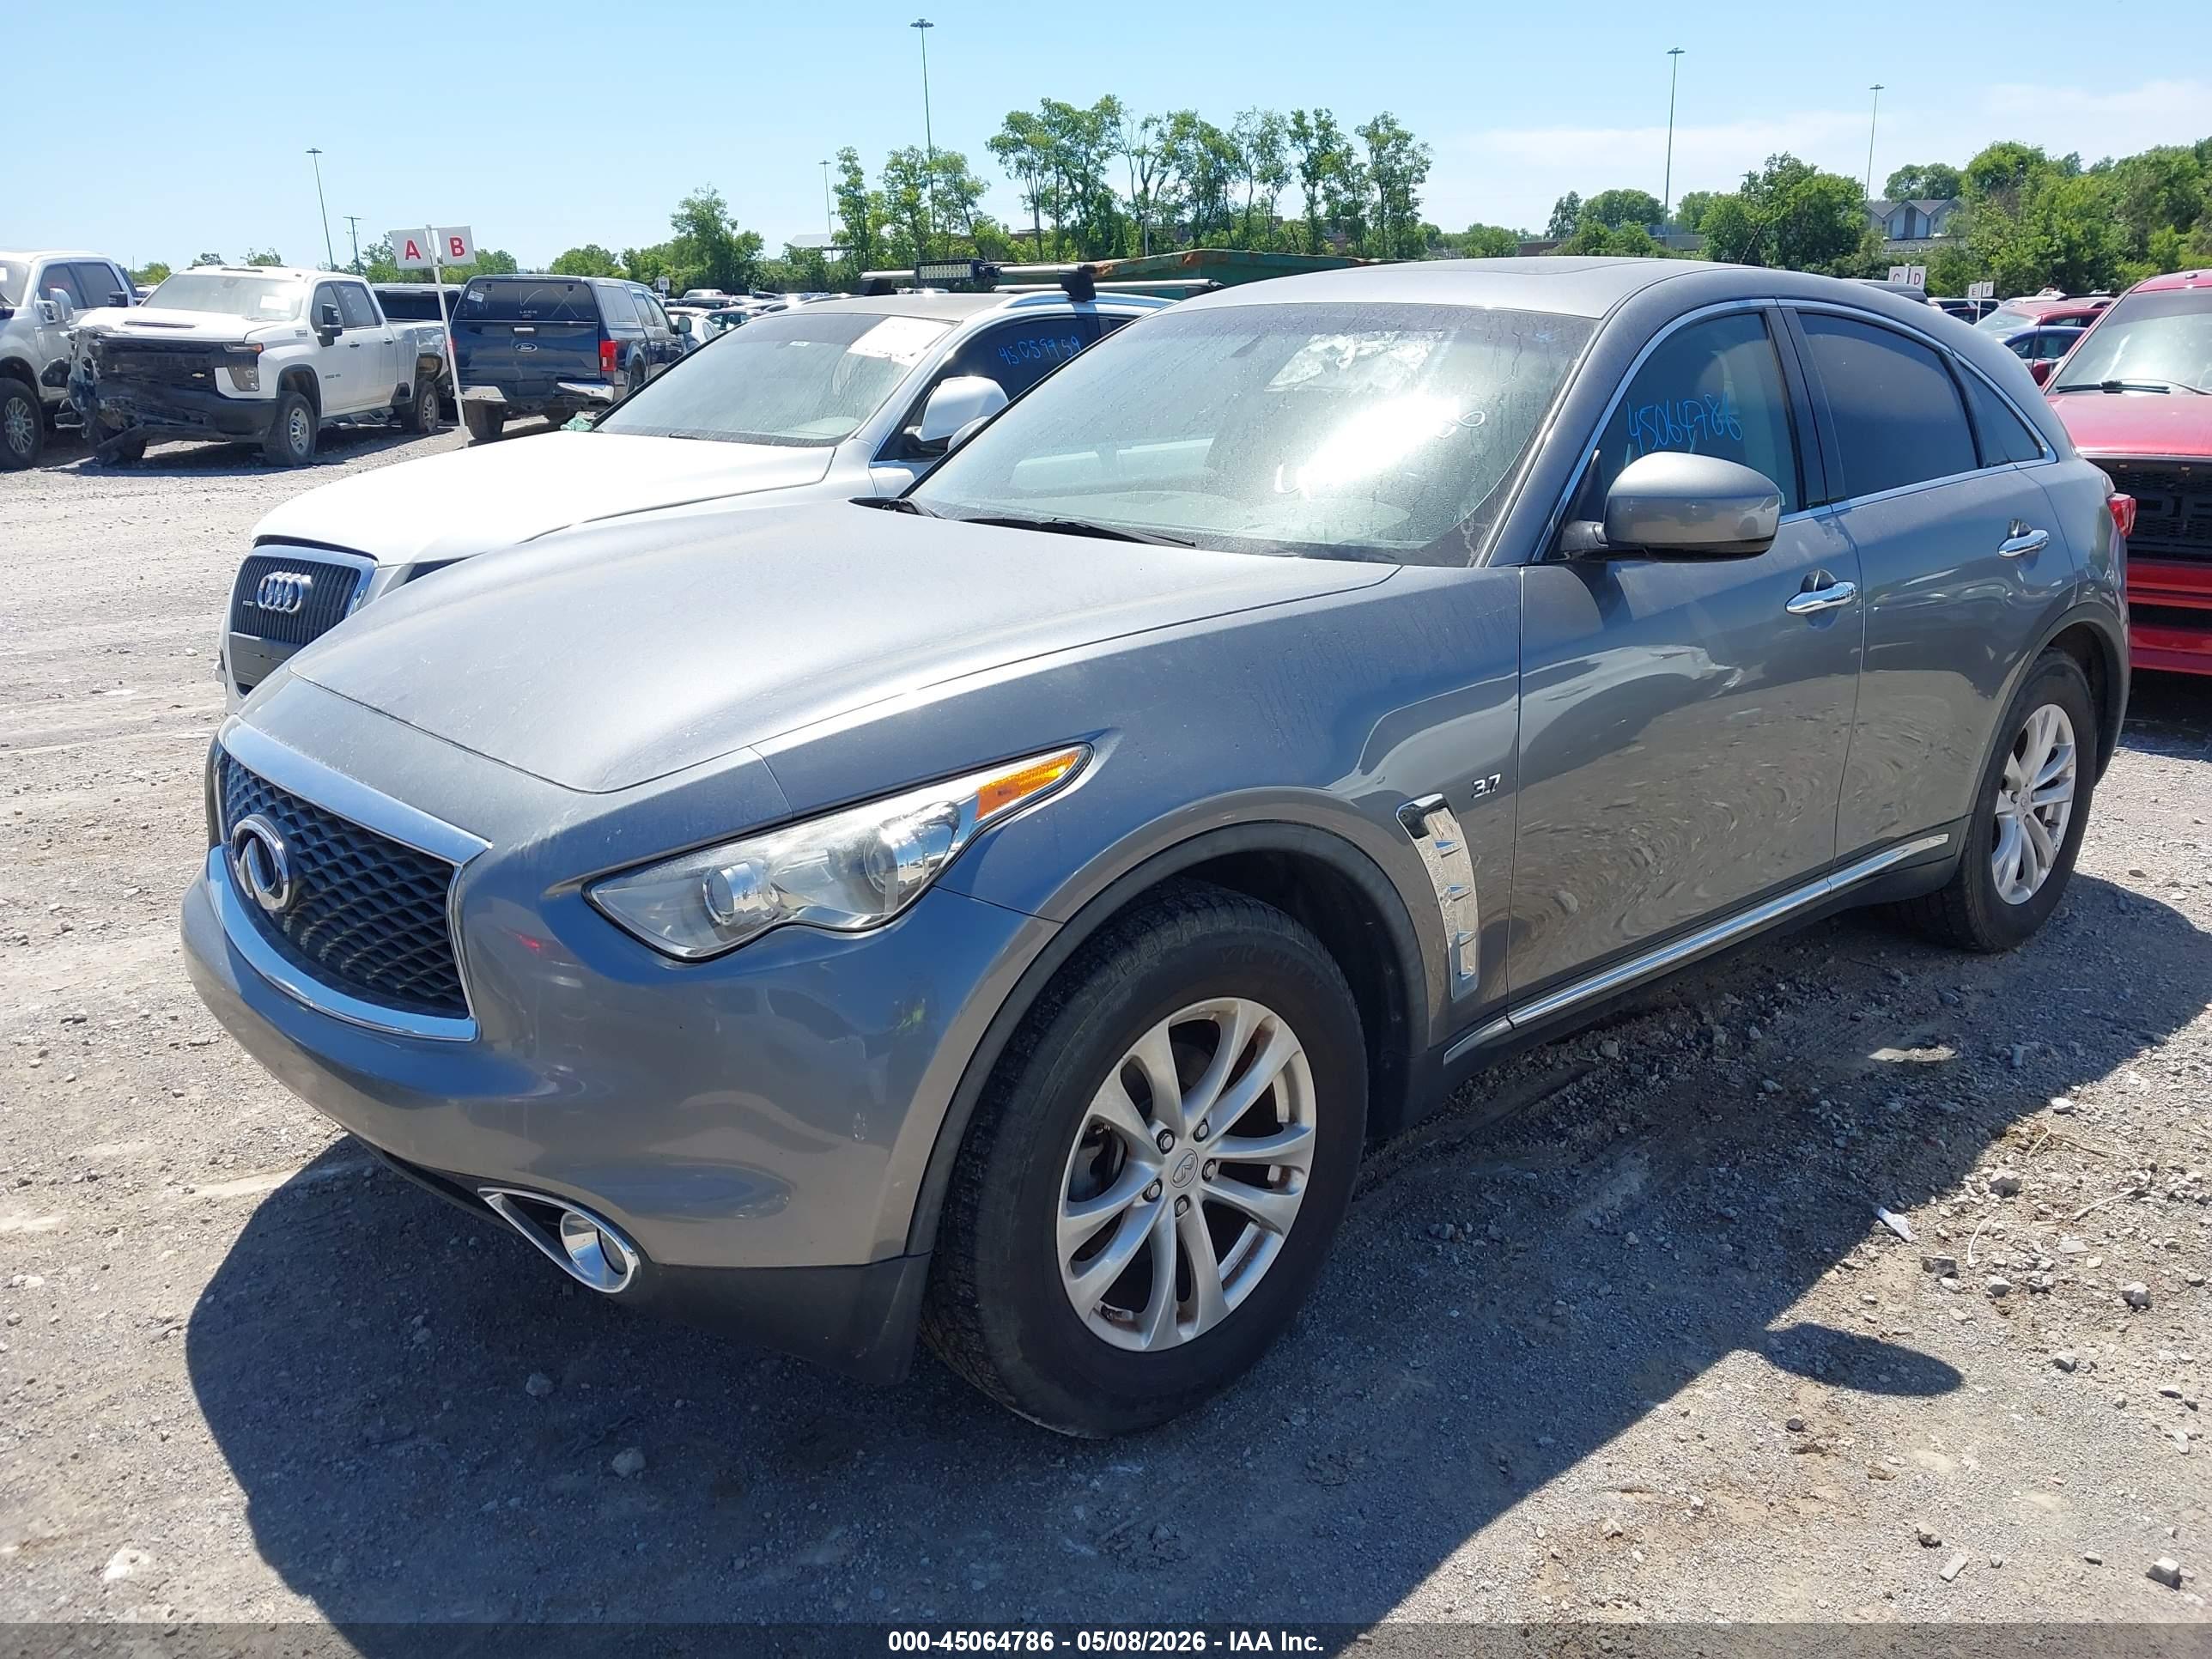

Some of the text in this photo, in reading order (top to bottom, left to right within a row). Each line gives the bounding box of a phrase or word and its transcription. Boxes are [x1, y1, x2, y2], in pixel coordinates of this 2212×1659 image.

[405, 240, 422, 260] A
[449, 237, 465, 257] B
[1913, 273, 1921, 285] D
[1626, 392, 1743, 456] 45064786
